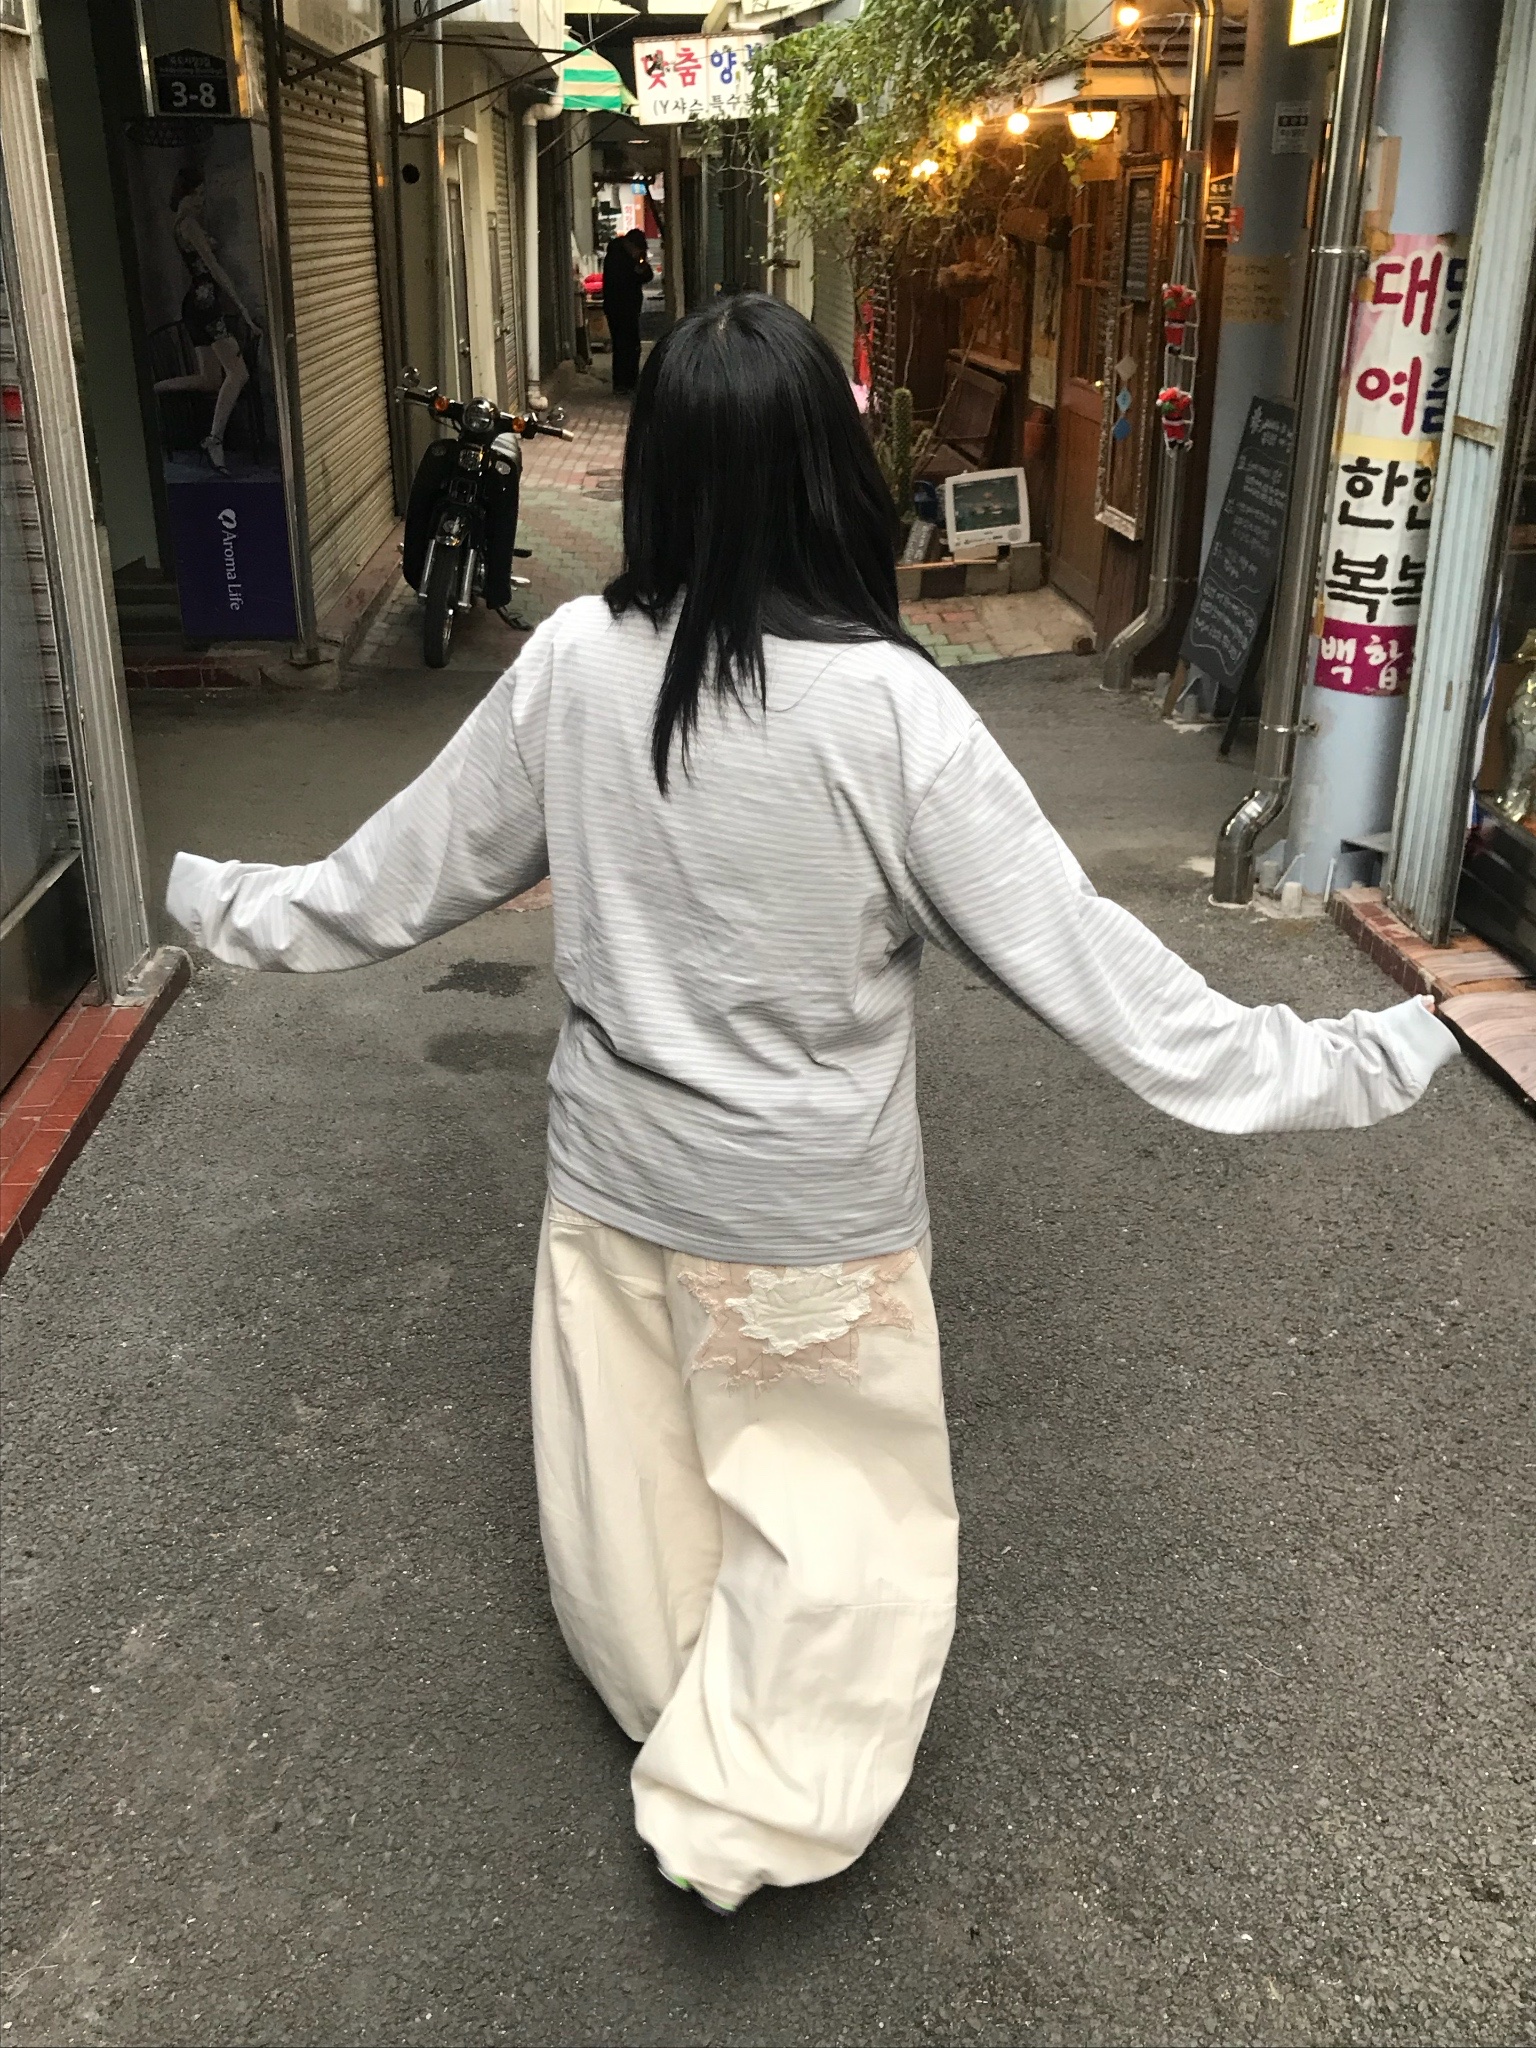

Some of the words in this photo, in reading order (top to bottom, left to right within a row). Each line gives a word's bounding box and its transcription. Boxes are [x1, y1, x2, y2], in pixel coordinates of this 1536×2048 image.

[171, 81, 217, 109] 3-8
[221, 529, 237, 580] Aroma
[1325, 456, 1408, 623] 한복
[228, 584, 244, 611] Life
[1320, 634, 1415, 690] 백합
